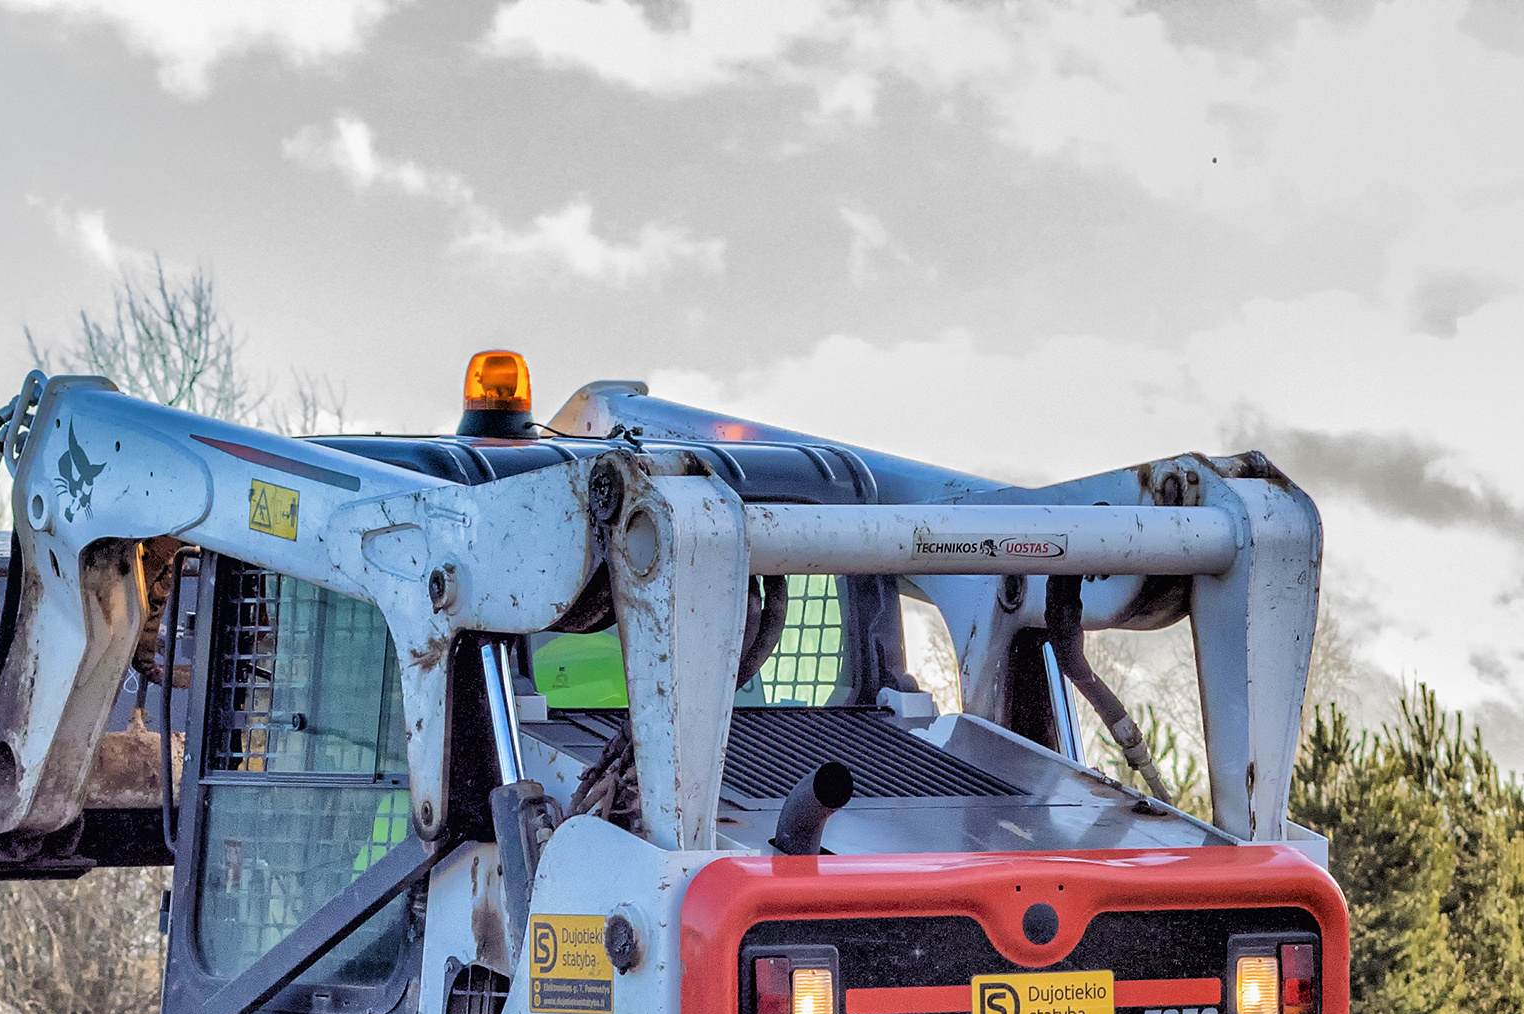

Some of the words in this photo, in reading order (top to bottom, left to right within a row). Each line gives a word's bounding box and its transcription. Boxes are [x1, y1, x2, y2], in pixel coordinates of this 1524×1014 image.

[915, 542, 978, 554] TECHNIKOS
[1006, 542, 1049, 554] UOSTAS
[561, 927, 604, 948] Dujotieki
[562, 949, 596, 971] statyba
[1028, 982, 1107, 1005] Dujotiekio
